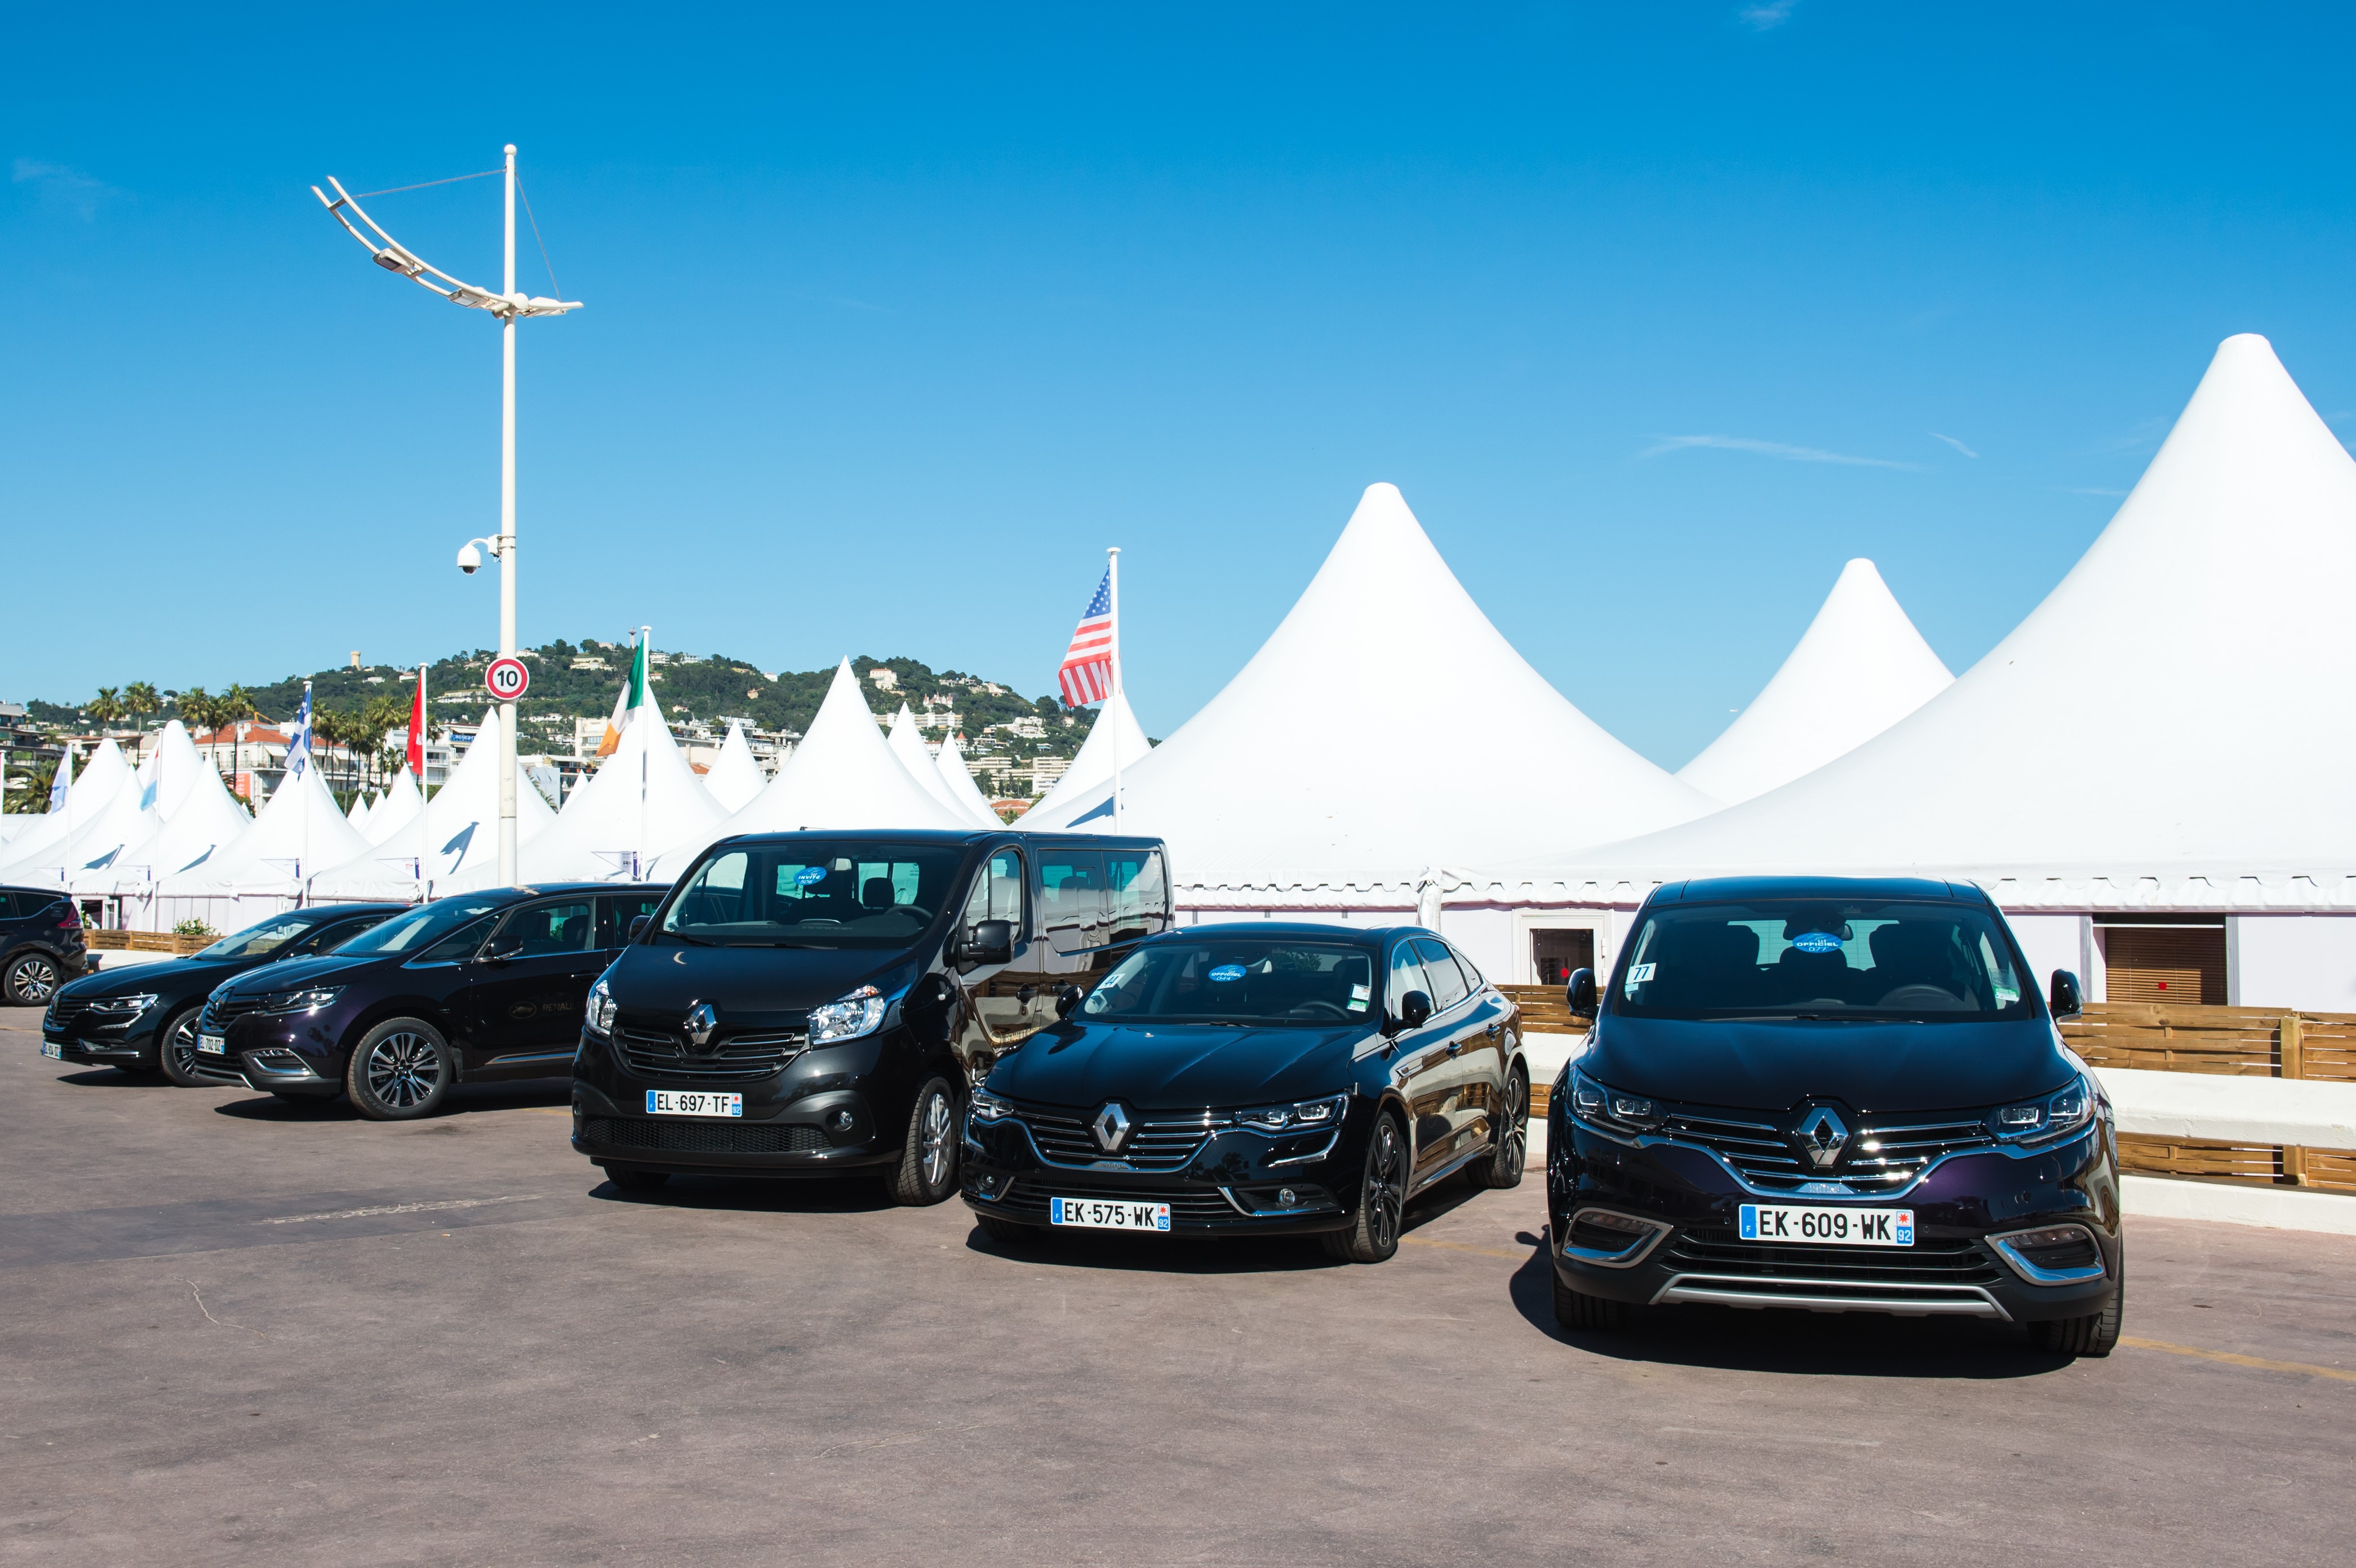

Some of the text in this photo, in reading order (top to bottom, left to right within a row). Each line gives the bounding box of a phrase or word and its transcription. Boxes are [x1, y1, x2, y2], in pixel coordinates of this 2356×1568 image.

[497, 670, 518, 687] 10
[1104, 975, 1119, 987] 44
[1634, 966, 1650, 980] 77
[200, 1036, 221, 1052] EL-702-DZ
[657, 1094, 730, 1113] EL-697-TF
[1064, 1202, 1155, 1227] EK-575-WK
[1159, 1219, 1168, 1228] 92
[1759, 1210, 1891, 1240] EK-609-WK
[1898, 1229, 1911, 1242] 92
